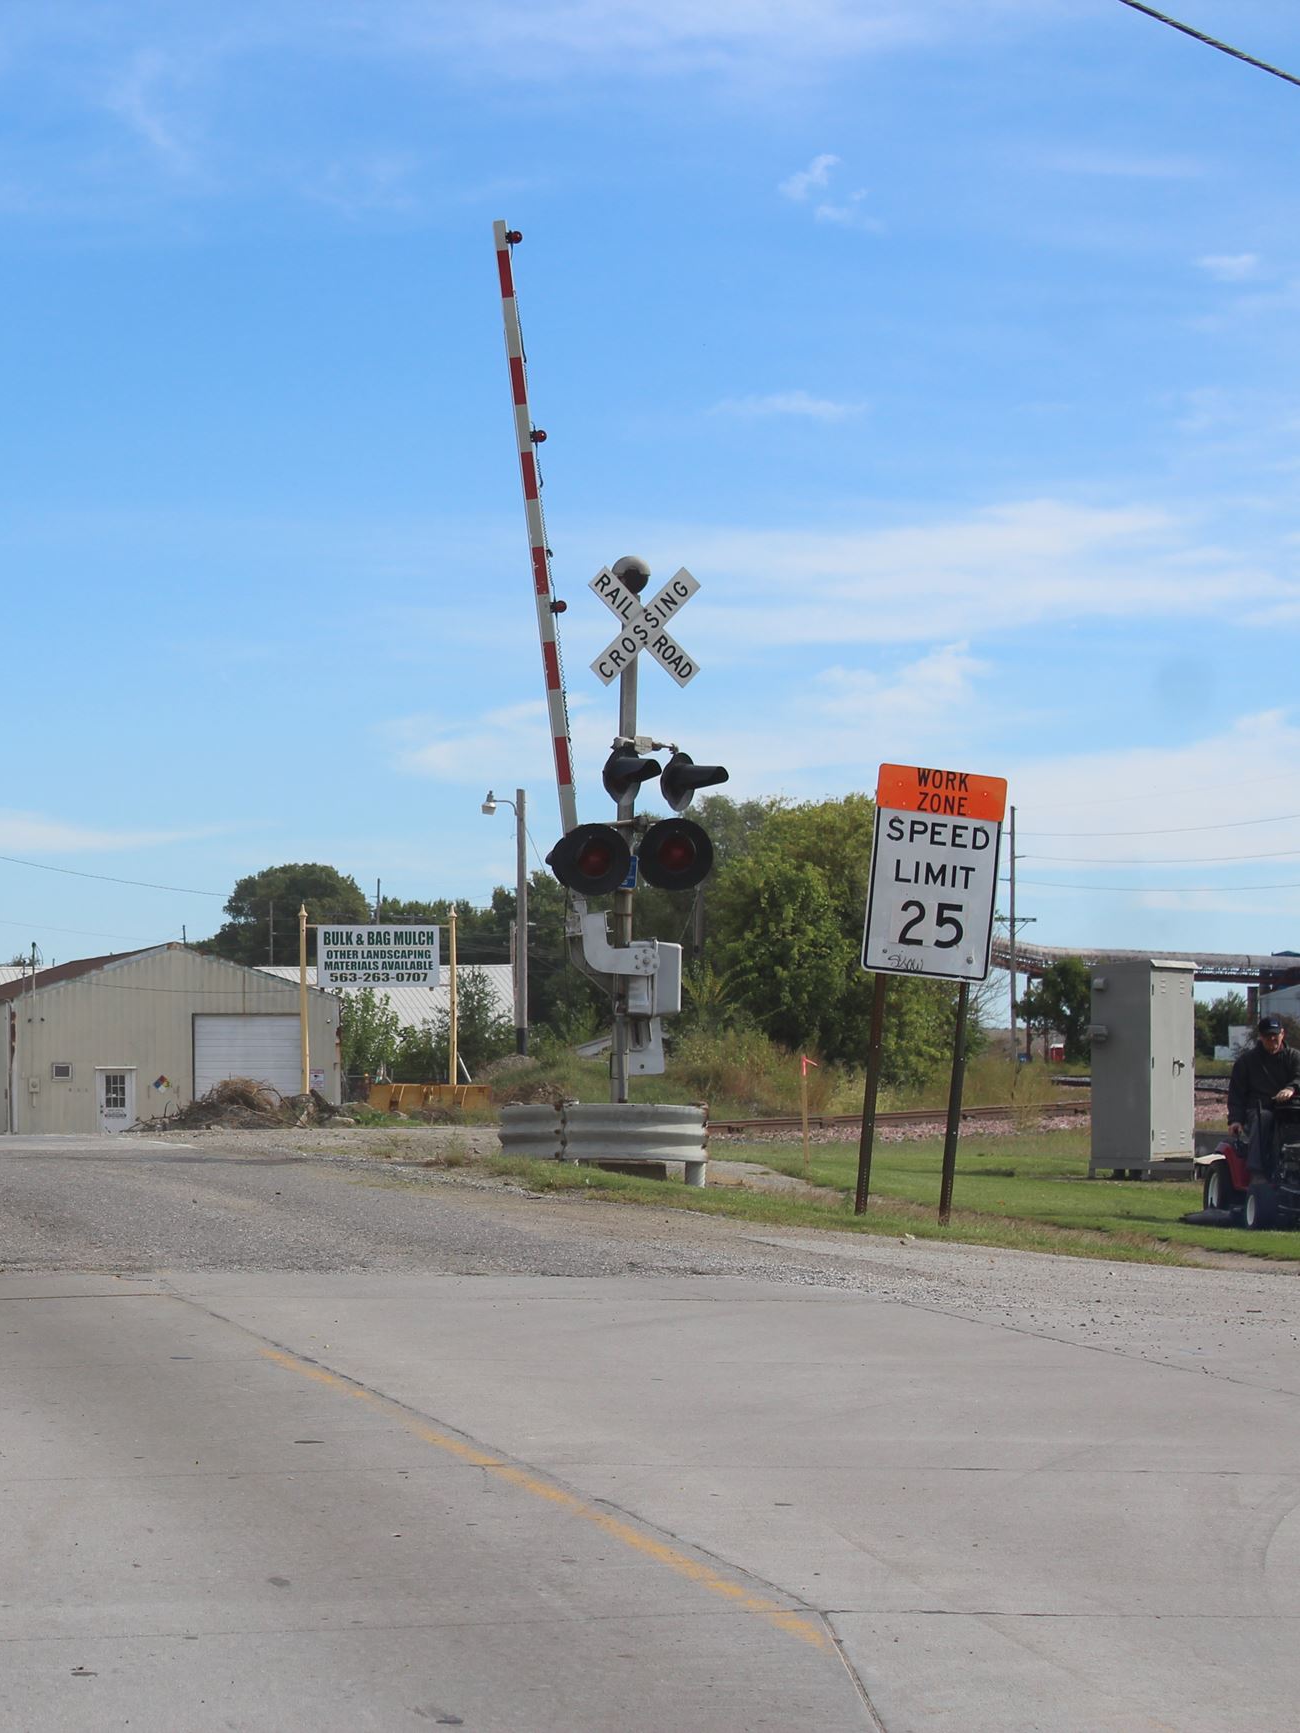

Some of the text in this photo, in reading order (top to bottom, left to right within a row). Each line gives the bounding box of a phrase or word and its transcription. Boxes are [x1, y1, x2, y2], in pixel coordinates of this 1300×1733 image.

[594, 573, 693, 679] RAIL ROAD
[598, 581, 689, 678] CROSSING
[916, 767, 970, 792] WORK
[916, 791, 968, 816] ZONE
[886, 815, 990, 851] SPEED
[894, 858, 976, 890] LIMIT
[897, 899, 964, 949] 25
[323, 931, 434, 946] BULK & BAG MULCH
[324, 960, 434, 971] MATERIALS AVAILABLE
[326, 949, 431, 960] OTHER LANDSCAPING
[329, 972, 428, 982] 563-263-0707
